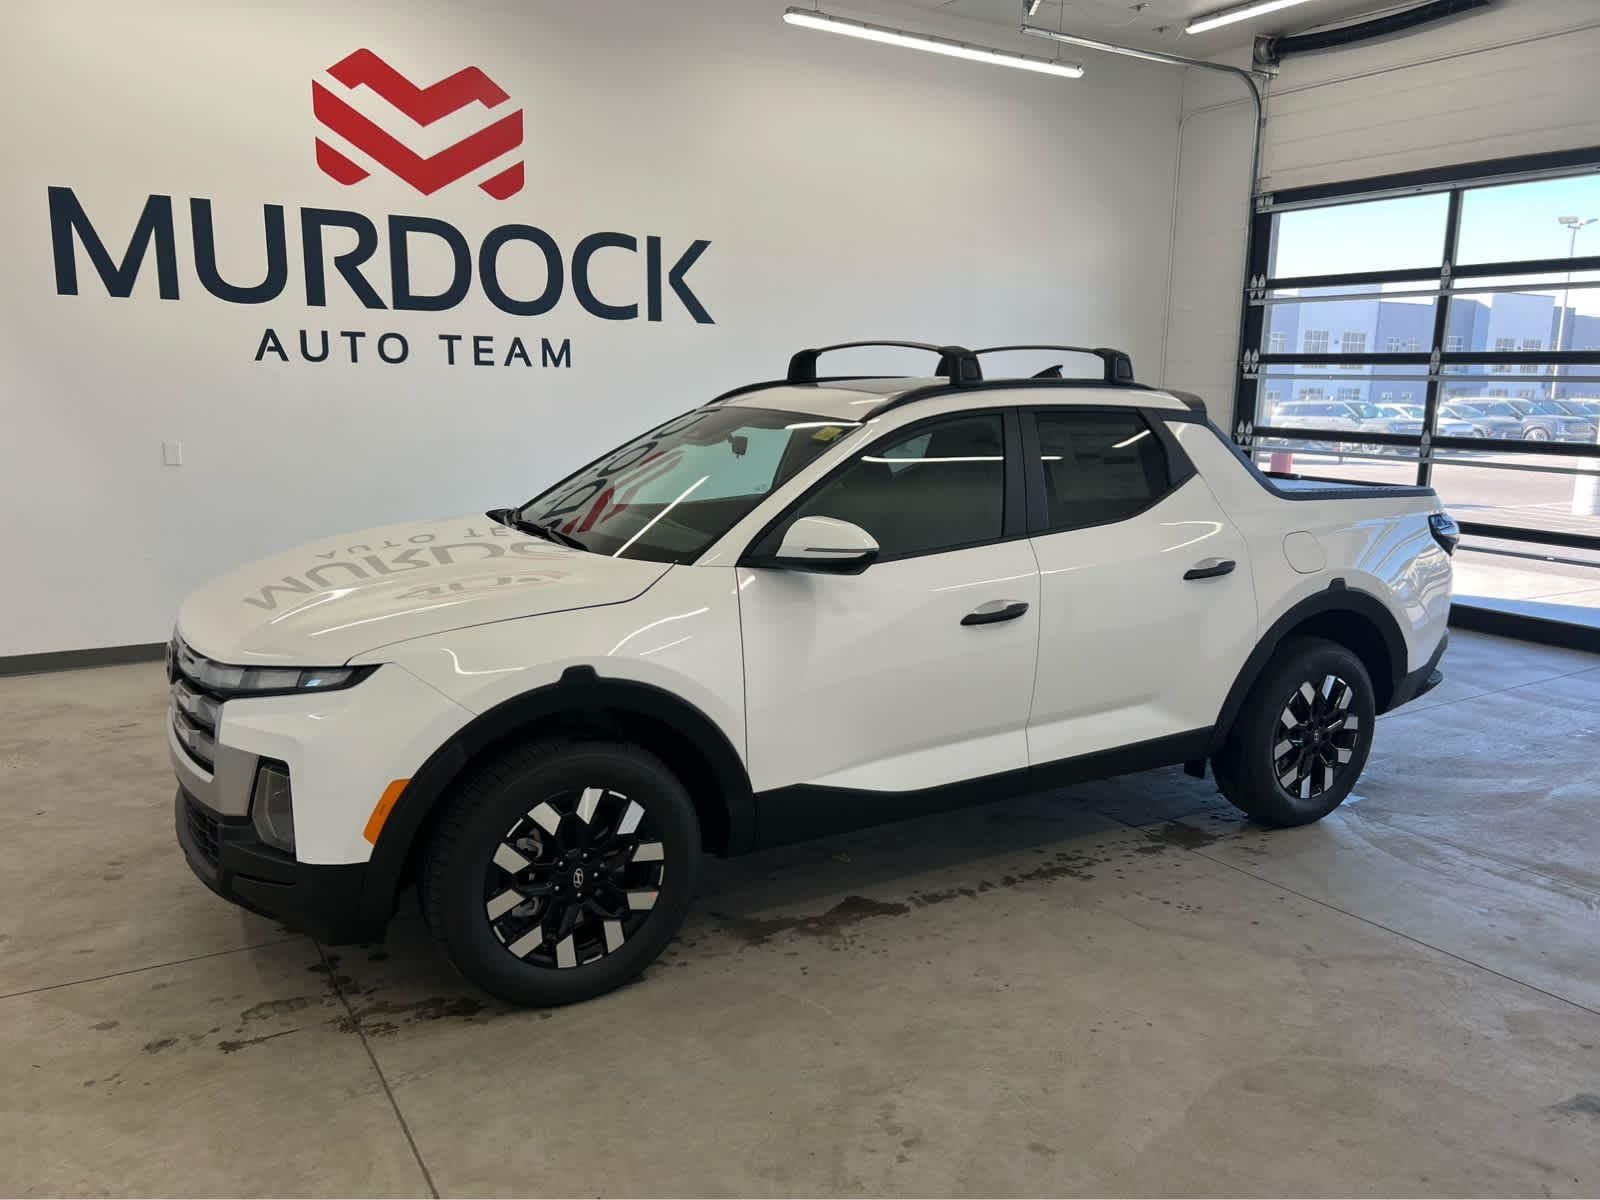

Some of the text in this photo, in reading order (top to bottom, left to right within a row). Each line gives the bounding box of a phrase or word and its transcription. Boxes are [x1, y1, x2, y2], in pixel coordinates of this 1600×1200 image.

[48, 185, 716, 325] MURDOCK
[254, 328, 571, 369] AUTO TEAM
